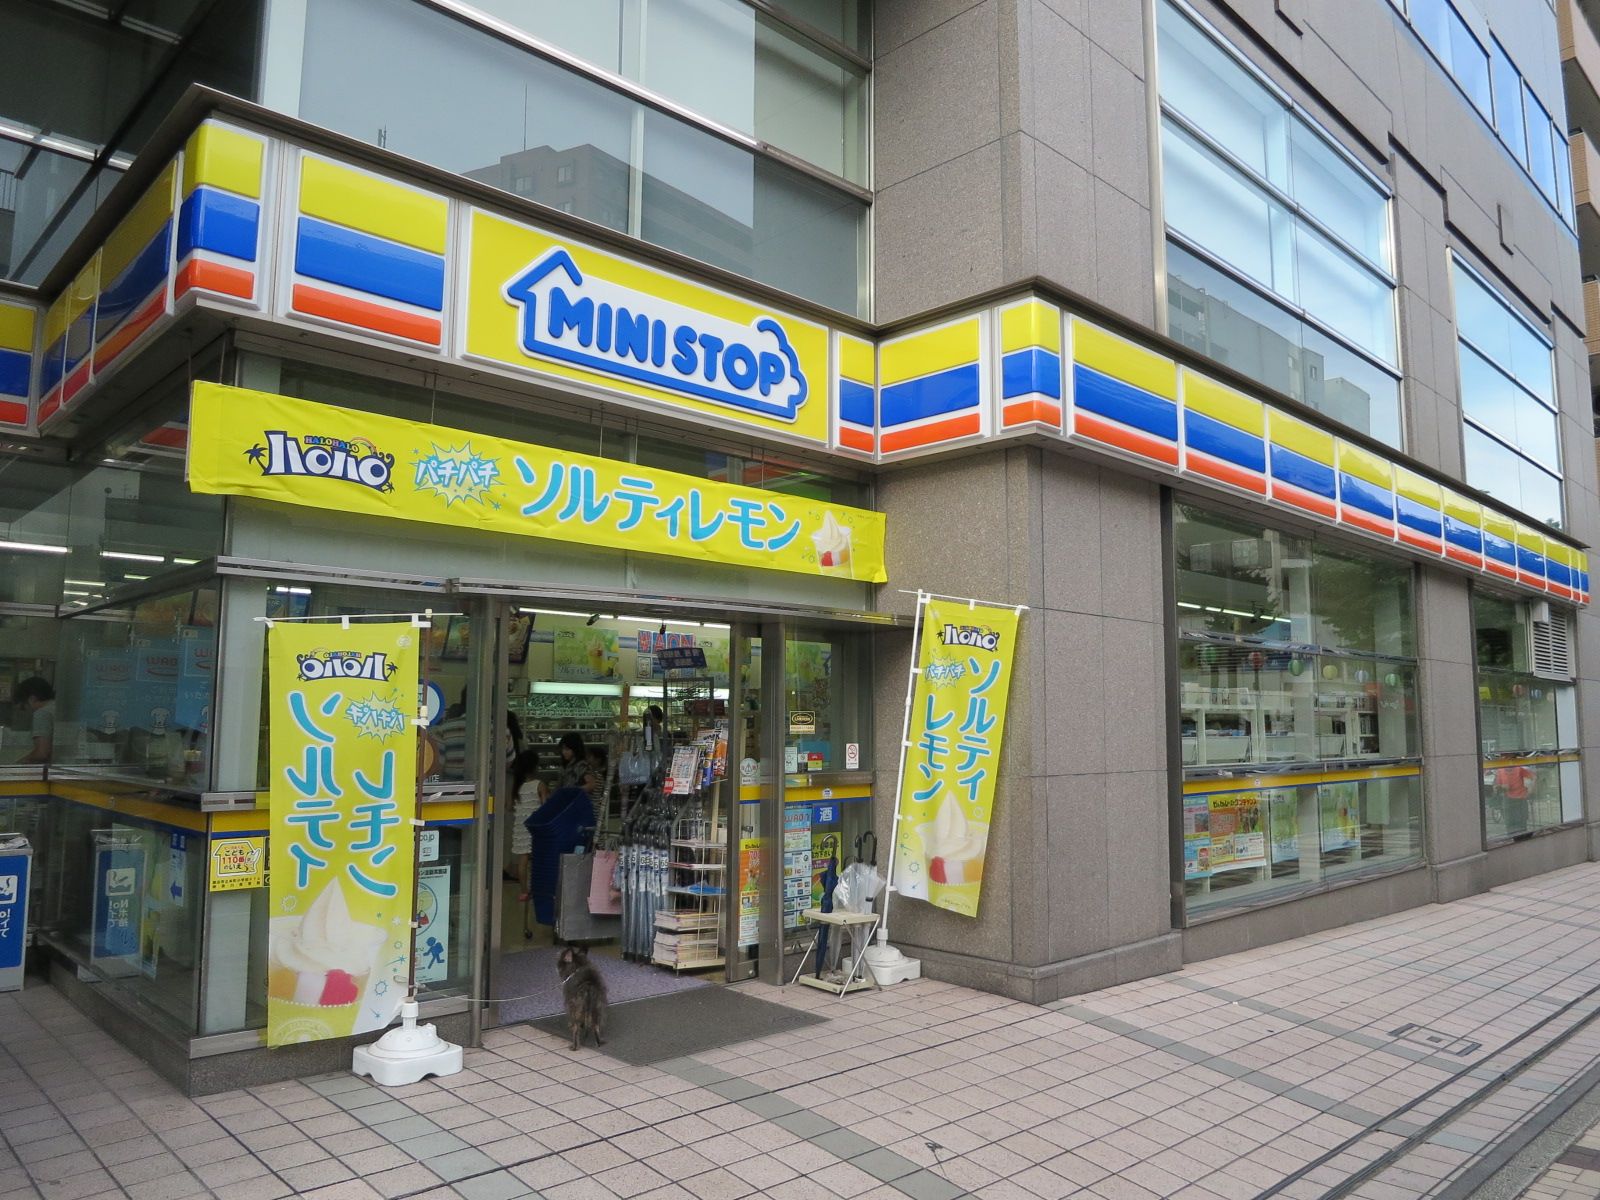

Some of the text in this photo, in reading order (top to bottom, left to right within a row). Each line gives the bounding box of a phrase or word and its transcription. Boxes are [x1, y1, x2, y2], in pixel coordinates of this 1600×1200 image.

[548, 286, 787, 397] MINISTOP
[304, 436, 359, 453] HALOHALO
[416, 457, 499, 488] パチパチ
[514, 456, 801, 551] ソルティレモン
[957, 657, 1001, 802] ソルティ
[913, 693, 955, 802] レモン
[820, 806, 833, 822] 酒
[225, 849, 245, 857] こども
[0, 908, 11, 918] o!
